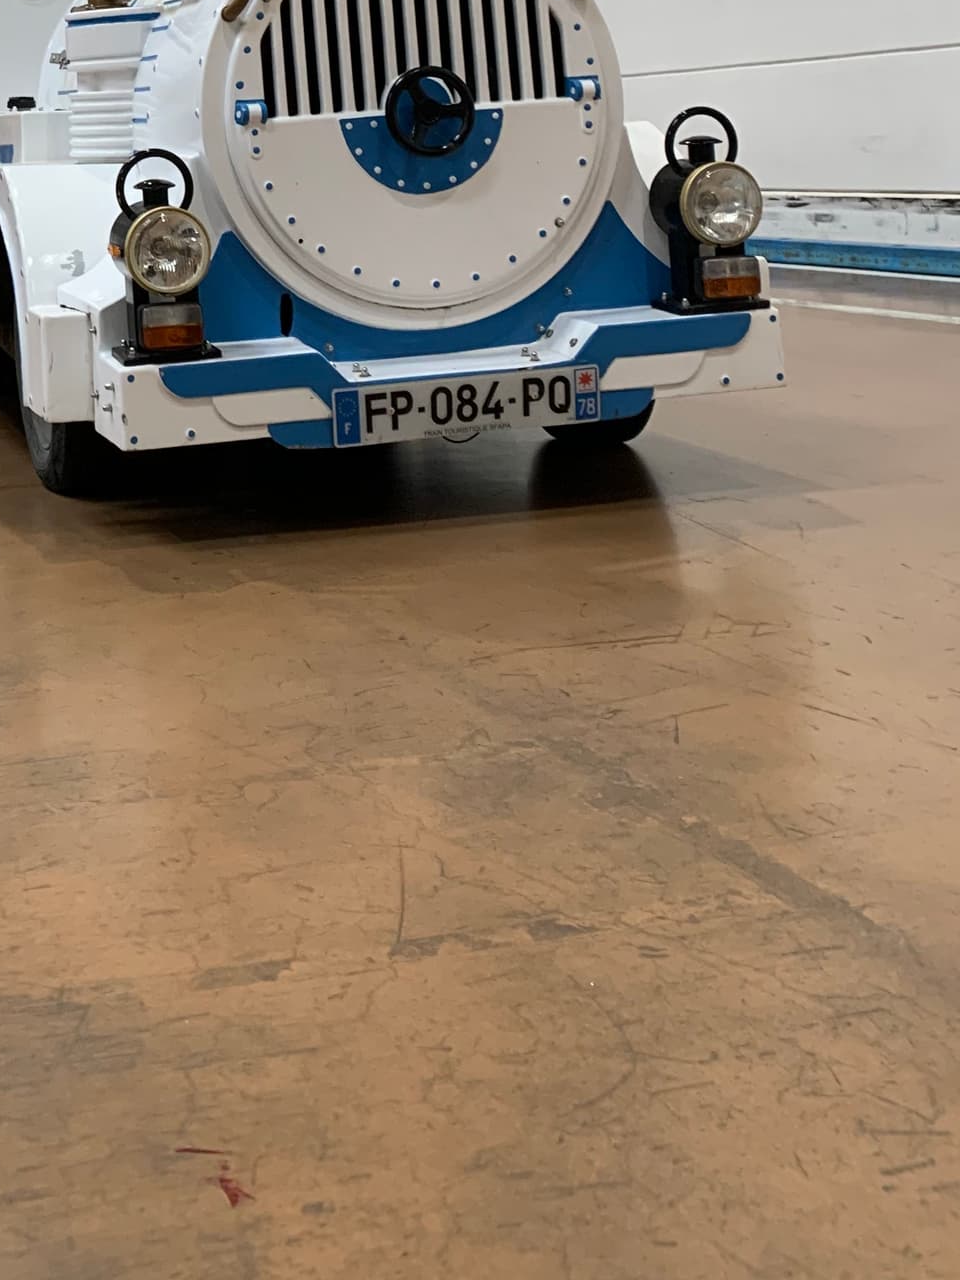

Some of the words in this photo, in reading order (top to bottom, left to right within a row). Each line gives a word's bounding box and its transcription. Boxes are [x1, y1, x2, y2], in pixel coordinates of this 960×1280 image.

[365, 375, 571, 434] FP-084-PQ
[579, 397, 596, 417] 78
[344, 421, 353, 436] F
